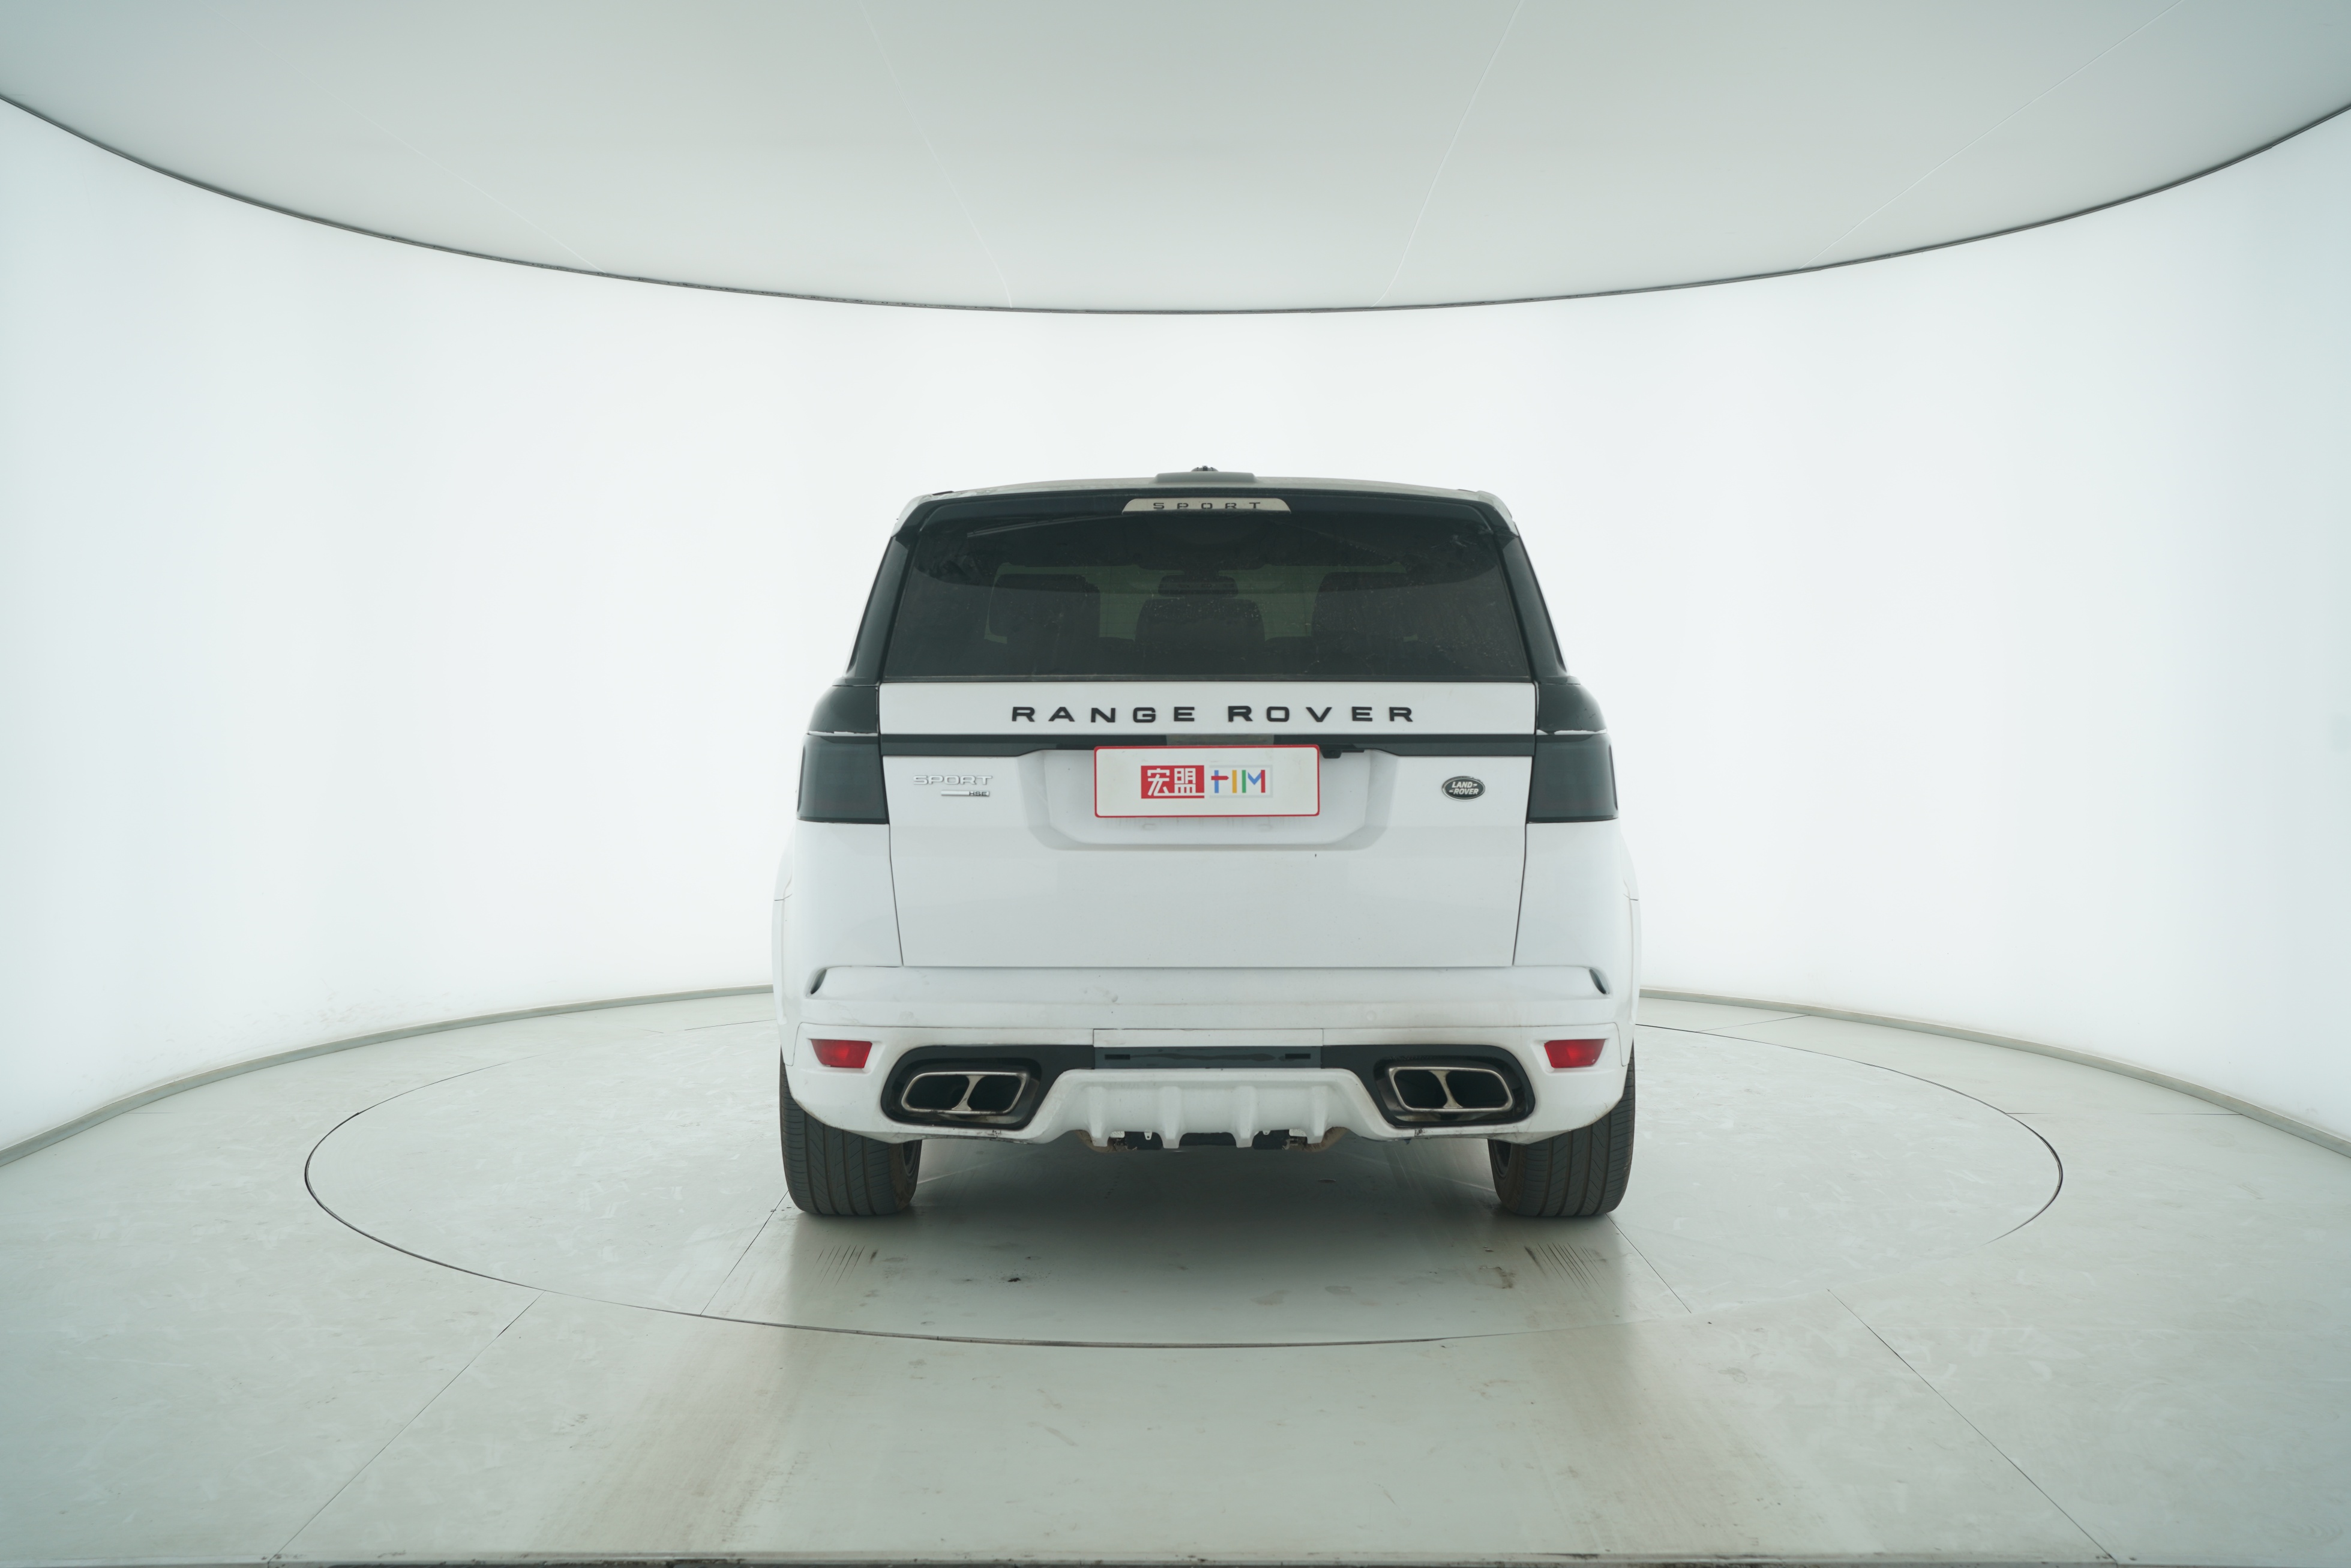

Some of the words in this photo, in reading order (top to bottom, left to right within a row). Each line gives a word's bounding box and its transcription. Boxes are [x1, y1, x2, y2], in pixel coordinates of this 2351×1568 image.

[1012, 706, 1195, 722] RANGE
[1228, 705, 1413, 722] ROVER
[913, 775, 992, 785] SPORT
[1147, 767, 1198, 796] 宏盟
